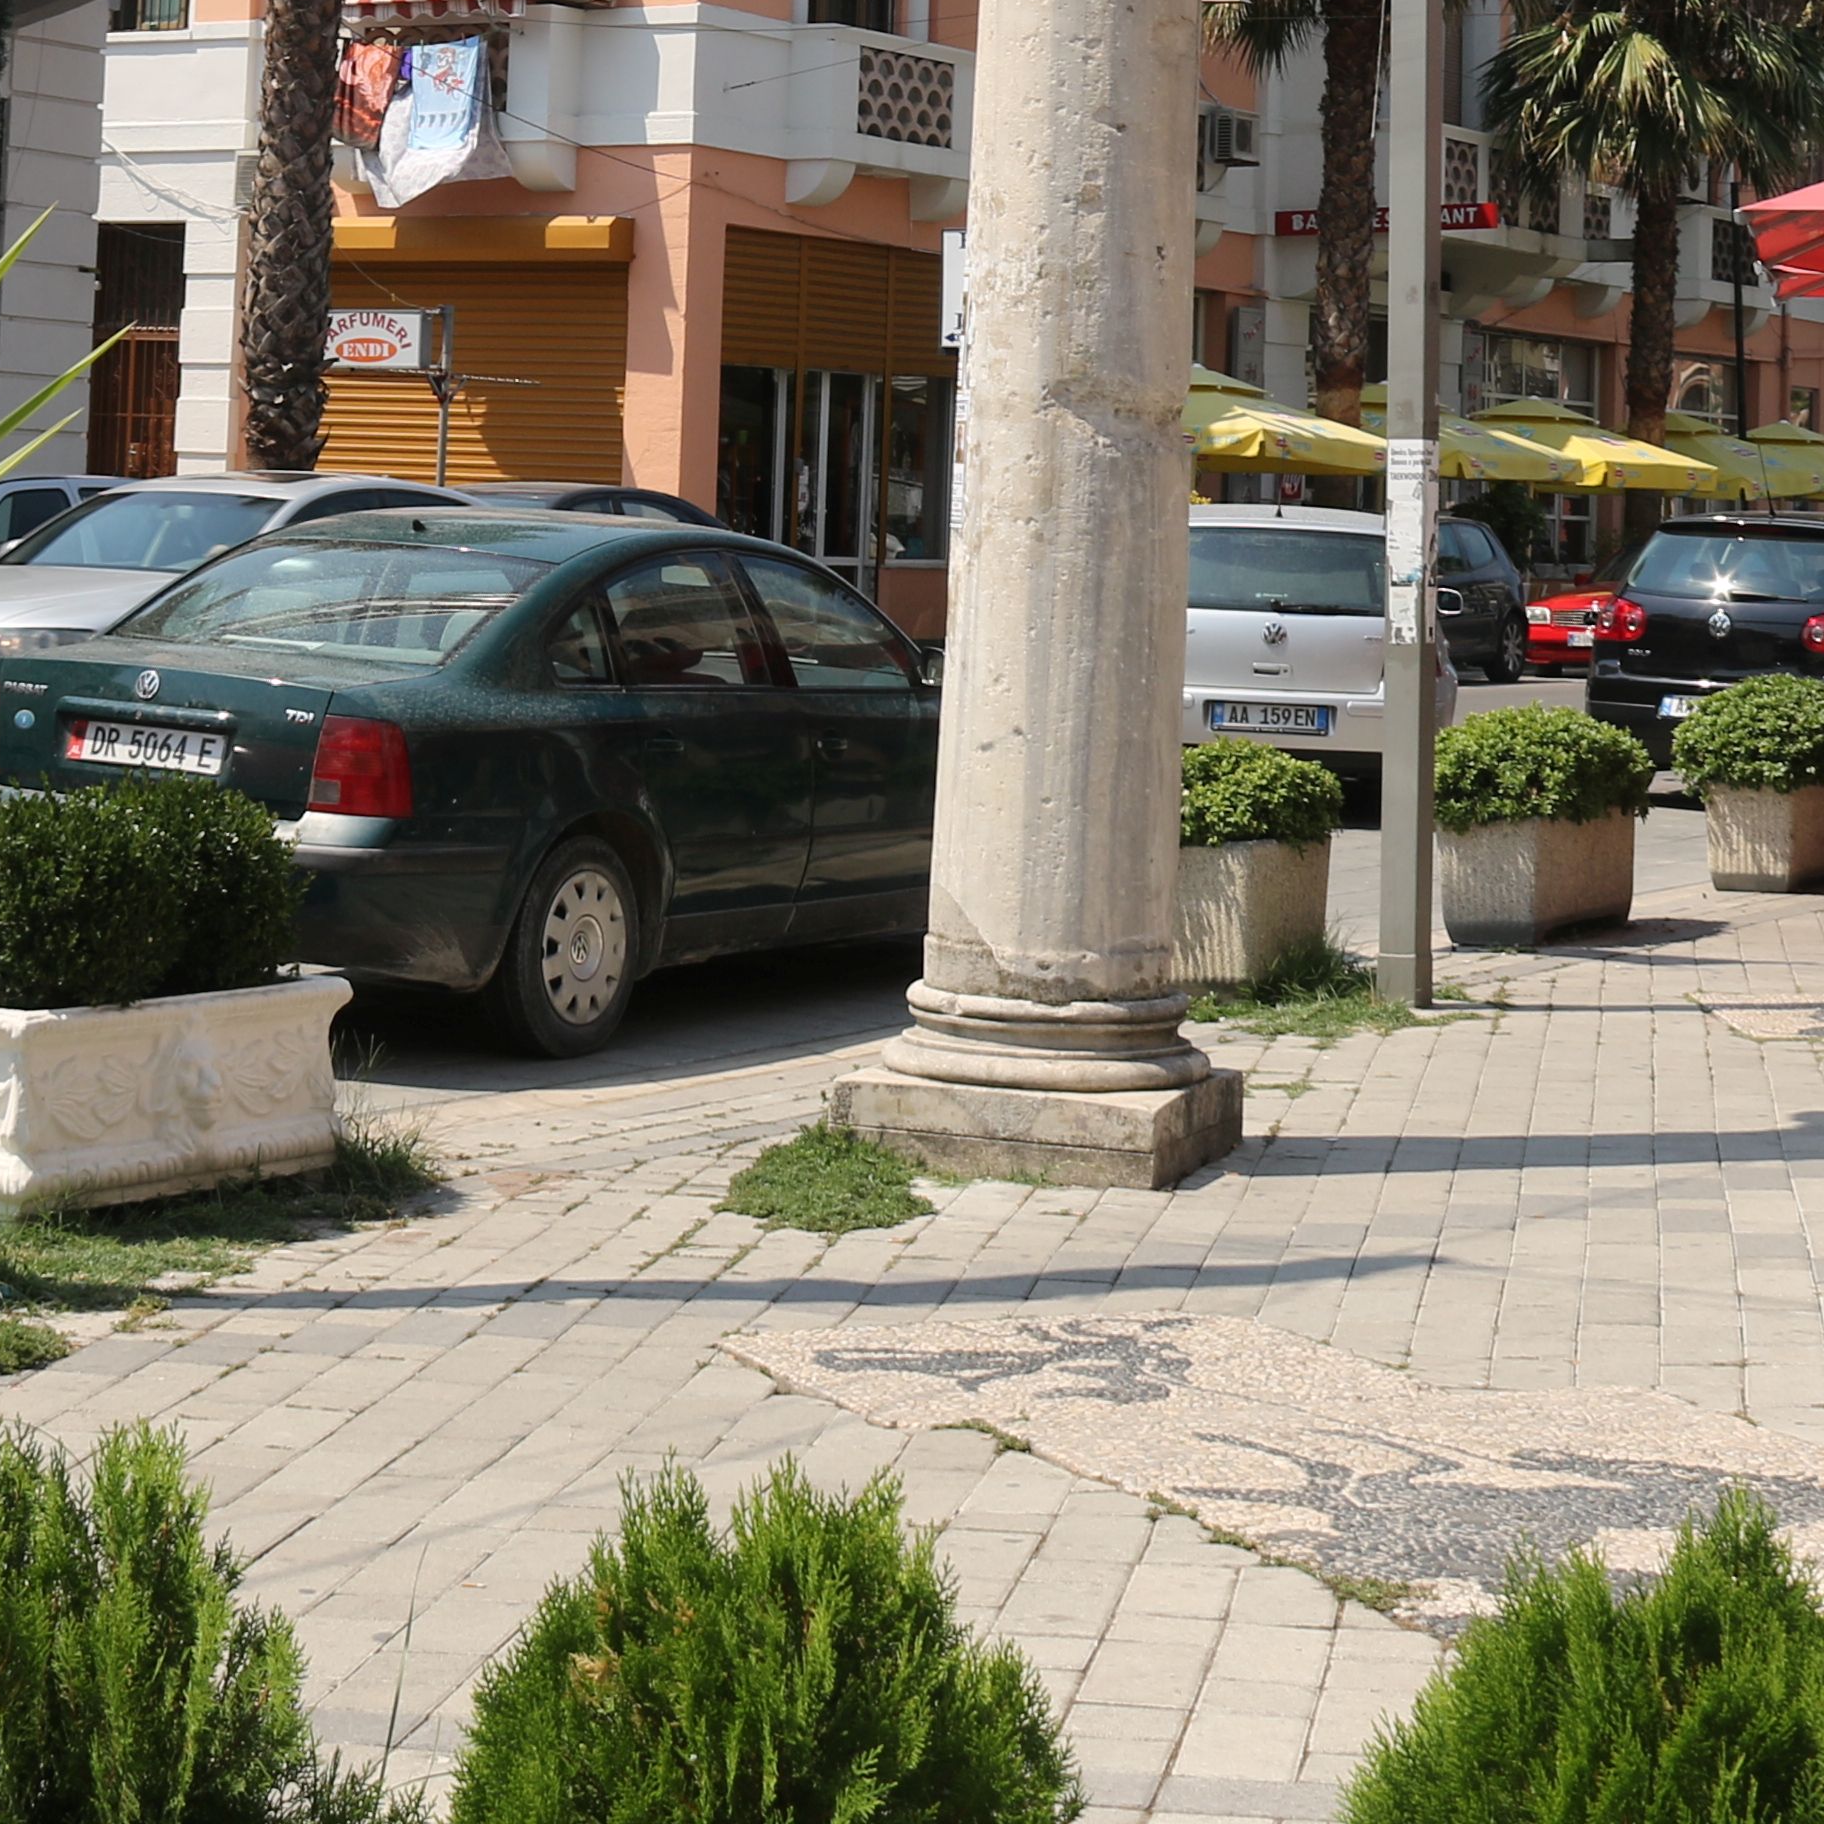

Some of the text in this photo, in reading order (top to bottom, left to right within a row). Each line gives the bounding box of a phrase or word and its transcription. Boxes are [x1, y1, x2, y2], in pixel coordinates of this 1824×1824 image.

[323, 312, 413, 352] ARFUMERI
[342, 342, 390, 358] ENDI
[284, 707, 316, 724] TDI
[1228, 706, 1249, 725] AA
[90, 726, 217, 768] DR 5064 E
